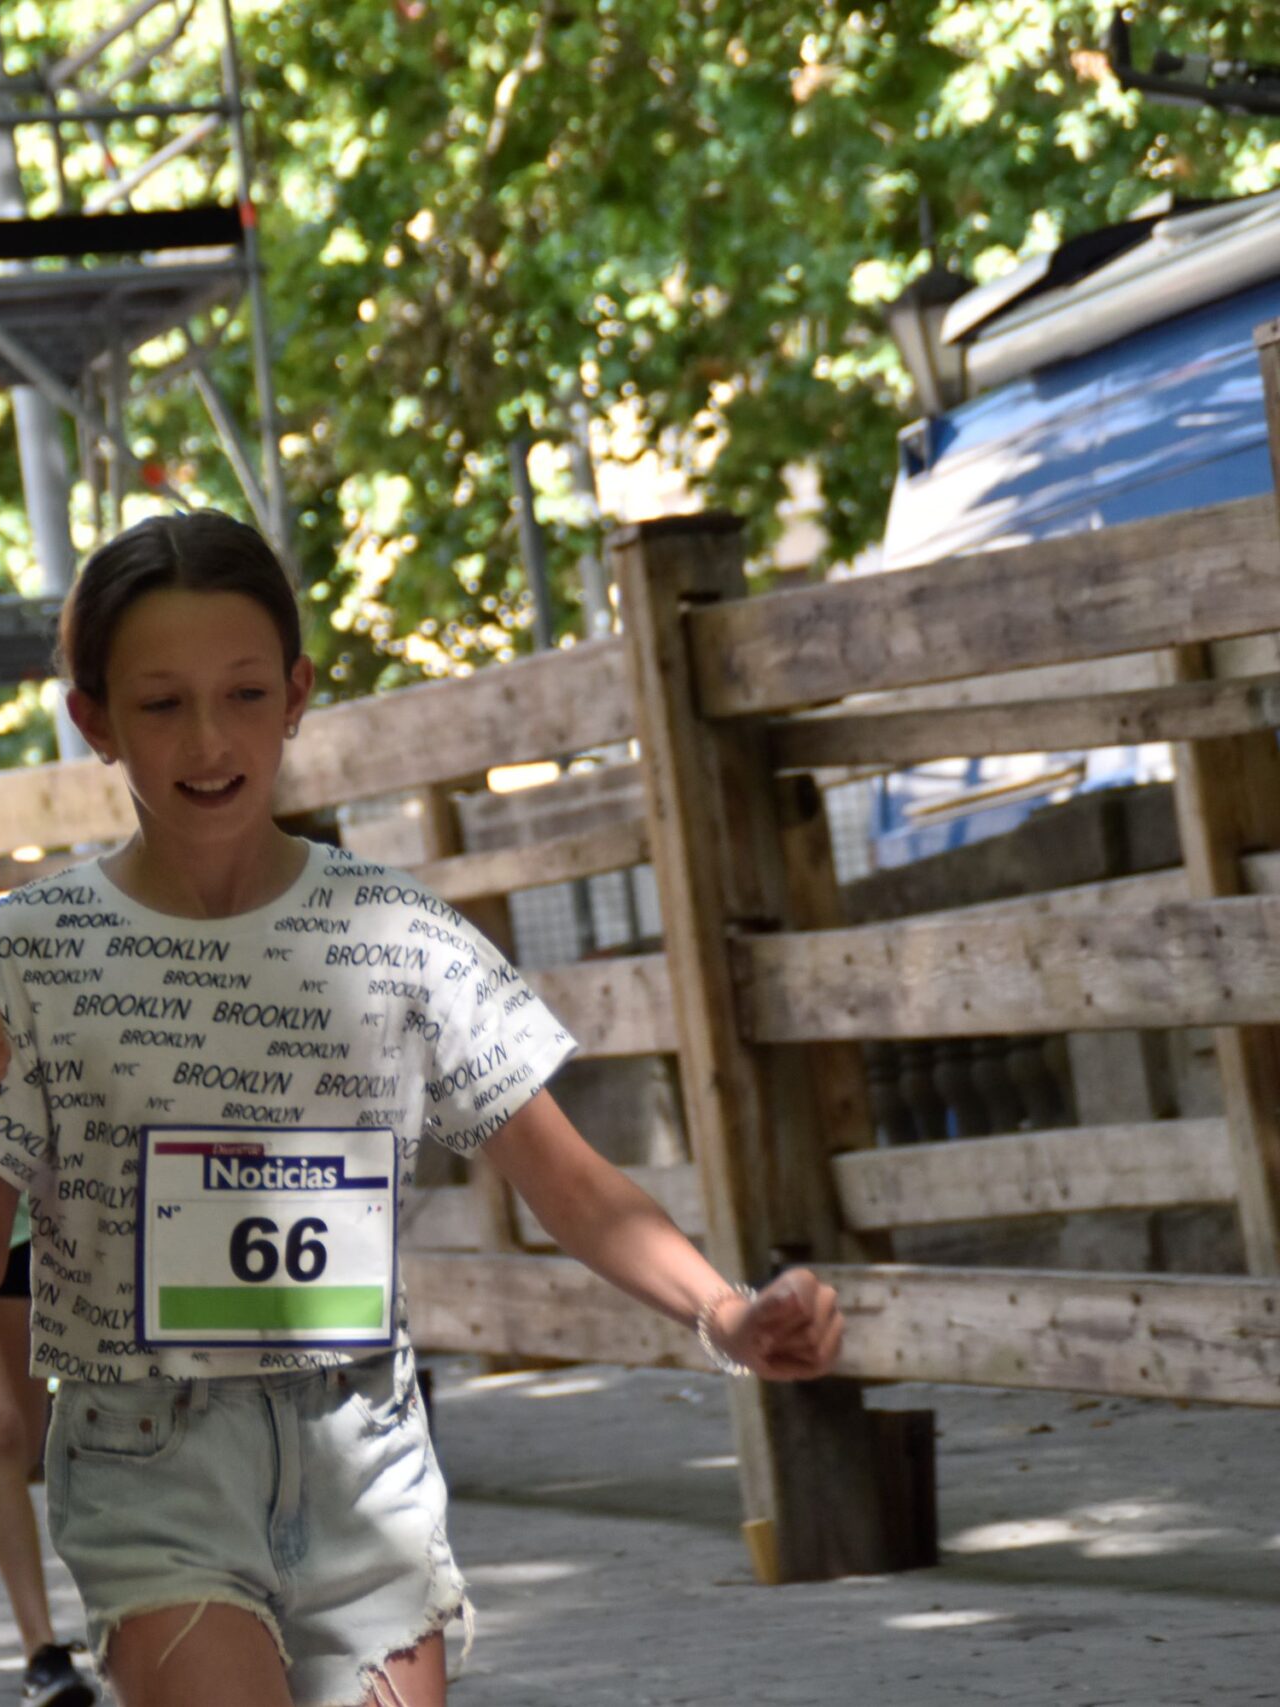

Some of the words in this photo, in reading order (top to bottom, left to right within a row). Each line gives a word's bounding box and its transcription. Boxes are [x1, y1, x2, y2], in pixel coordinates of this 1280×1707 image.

[323, 864, 386, 878] OOKLYN
[354, 885, 465, 929] BROOKLYN
[105, 935, 231, 963] BROOKLYN
[263, 947, 294, 962] NYC
[325, 942, 430, 971] BROOKLYN
[22, 966, 104, 986] BROOKLYN
[162, 970, 252, 990] BROOKLYN
[299, 978, 329, 994] NYC
[73, 994, 193, 1020] BROOKLYN
[211, 1001, 332, 1031] BROOKLYN
[51, 1032, 77, 1046] NYC
[119, 1029, 207, 1049] BROOKLYN
[266, 1041, 350, 1060] BROOKLYN
[110, 1062, 141, 1077] NYC
[173, 1061, 293, 1095] BROOKLYN
[314, 1071, 400, 1098] BROOKLYN
[472, 1062, 534, 1111] BROOKLYN
[48, 1092, 107, 1111] OOKLYN
[146, 1096, 176, 1112] NYC
[221, 1102, 305, 1123] BROOKLYN
[208, 1157, 338, 1190] Noticias
[228, 1216, 330, 1284] 66
[35, 1342, 123, 1385] BROOKLYN
